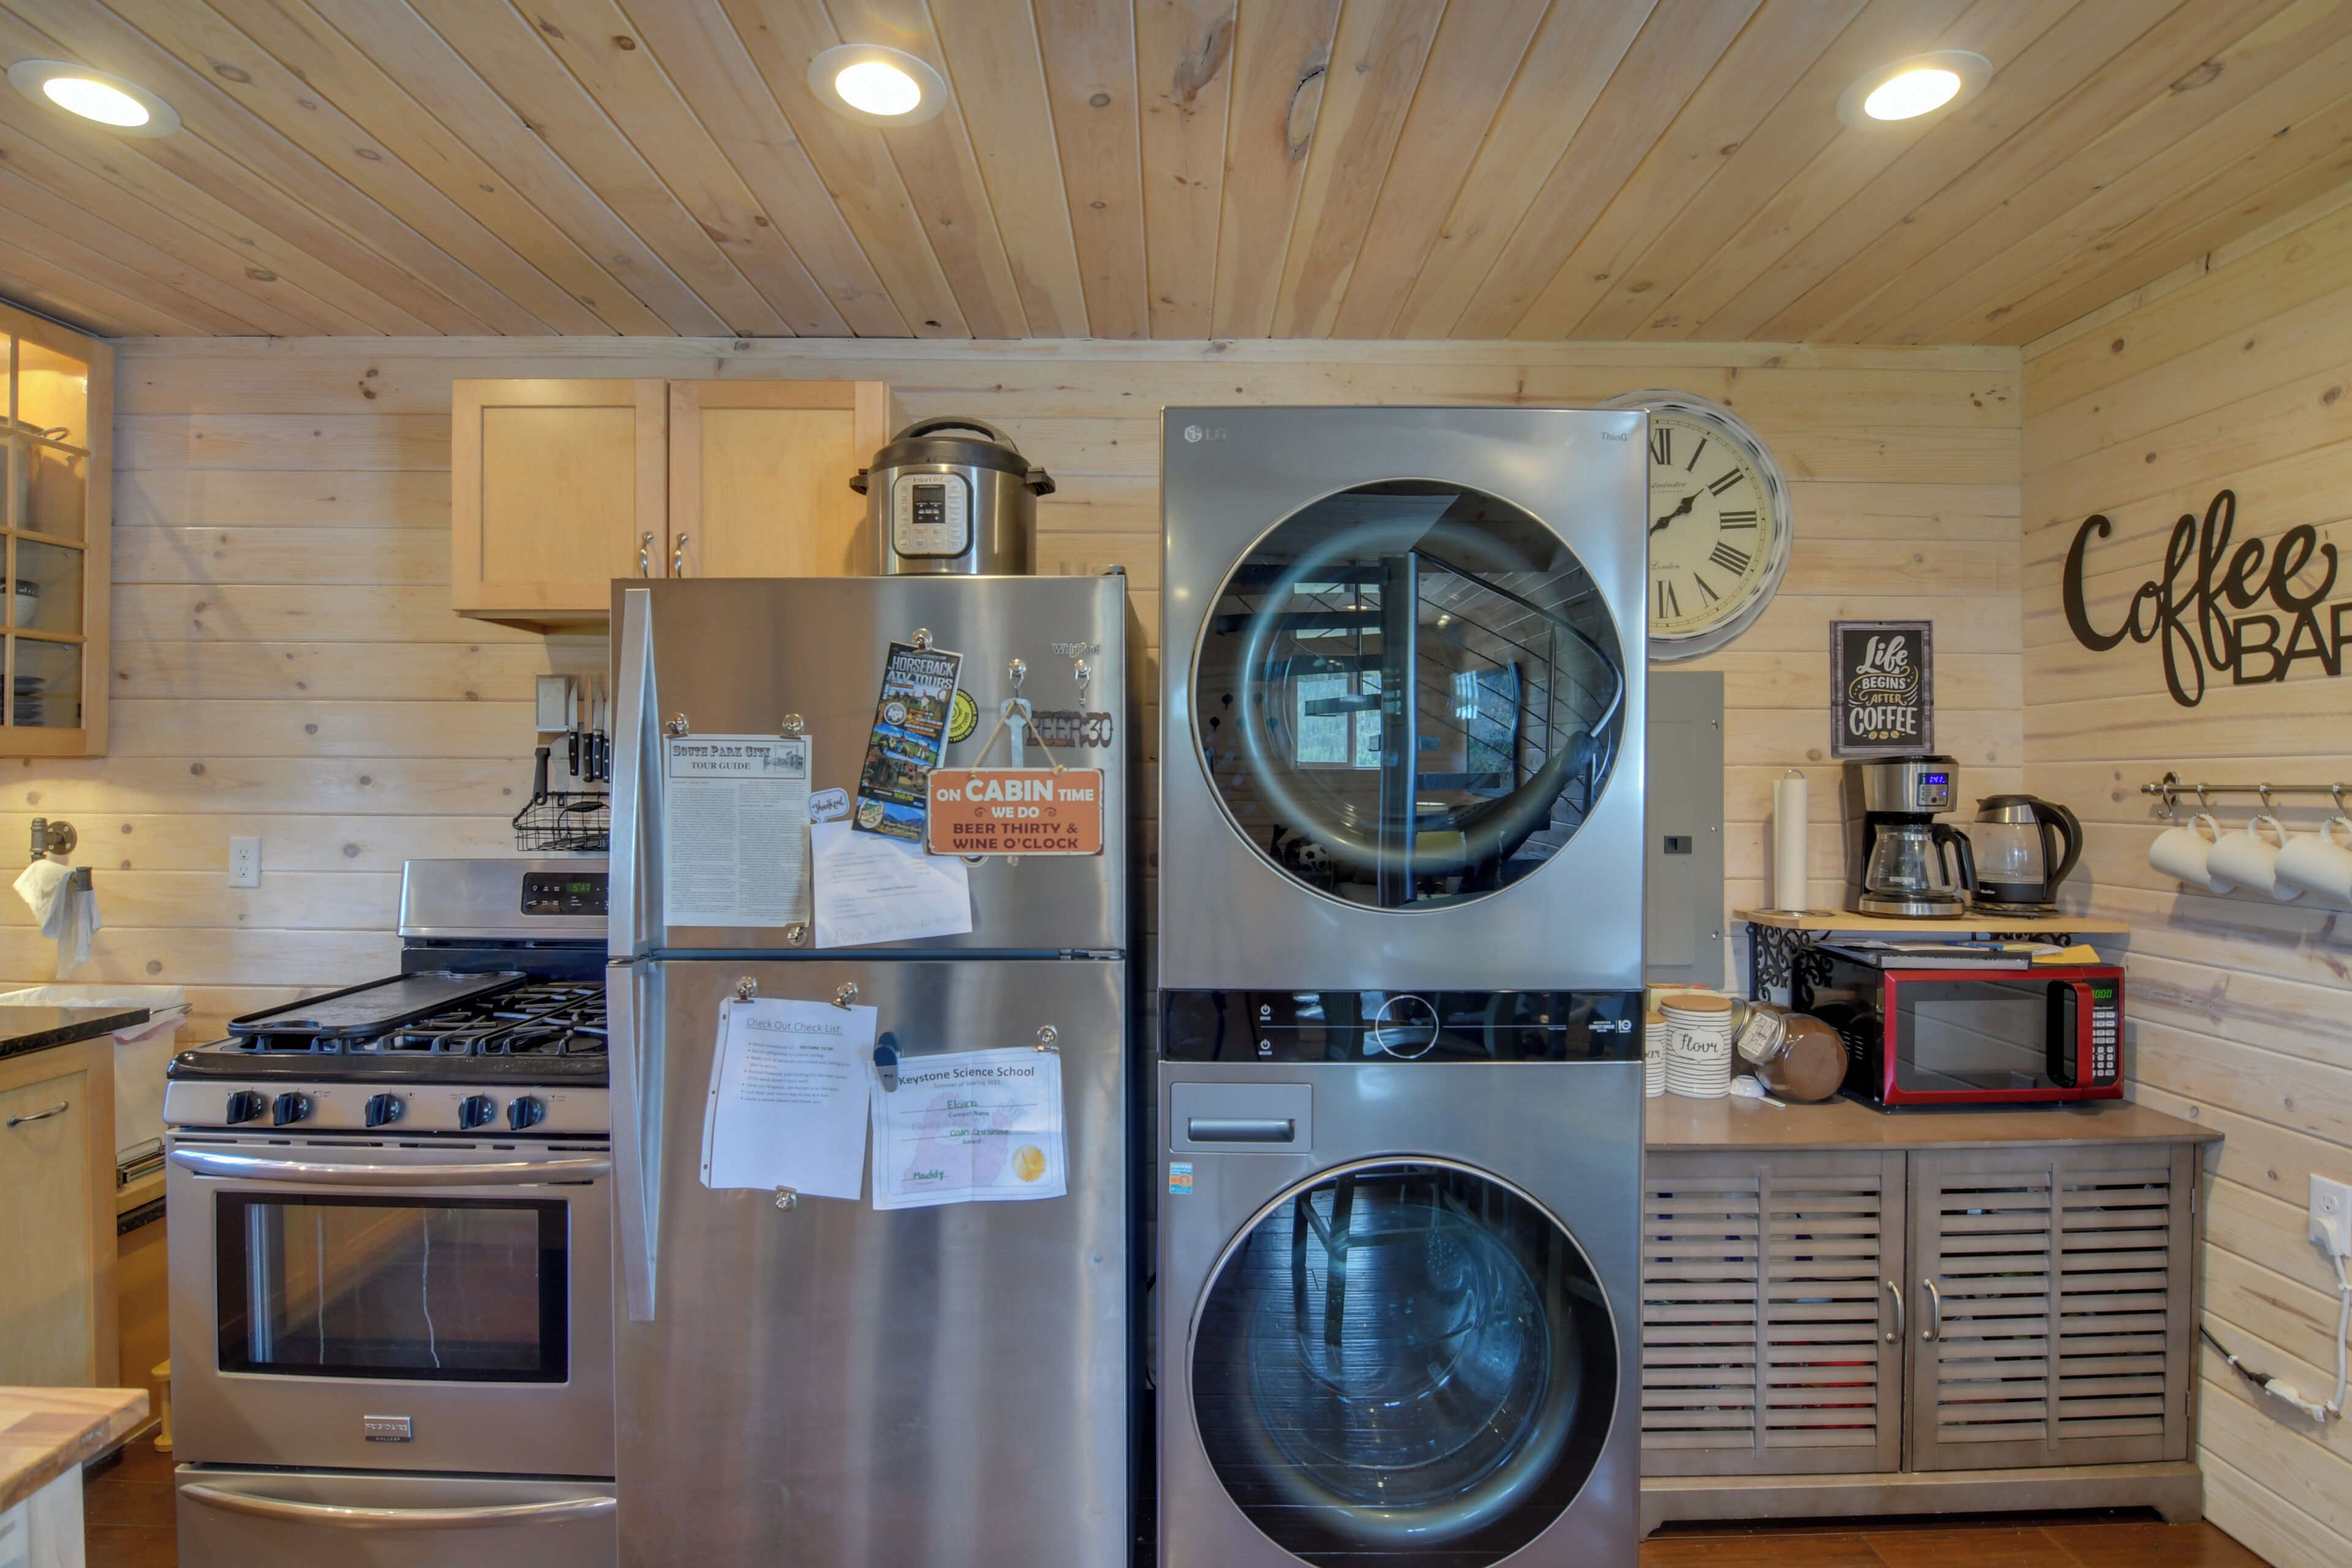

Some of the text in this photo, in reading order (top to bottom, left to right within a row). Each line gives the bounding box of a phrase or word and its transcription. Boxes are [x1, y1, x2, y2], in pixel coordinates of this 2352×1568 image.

[1206, 428, 1227, 440] LG
[1601, 432, 1627, 441] ThinQ
[2063, 489, 2338, 707] Coffee
[1856, 636, 1909, 674] Life
[891, 655, 955, 677] HORSEBACK
[914, 673, 954, 689] TOURS
[1862, 676, 1906, 689] BEGINS
[1866, 693, 1907, 706] AFTER
[1849, 706, 1918, 736] COFFEE
[691, 761, 751, 770] TOUR GUIDE
[936, 789, 961, 802] ON
[965, 779, 1054, 802] CABIN
[1058, 789, 1094, 802] TIME
[991, 807, 1039, 818] WE DO
[953, 823, 1078, 834] BEER THIRTY &
[953, 838, 1079, 849] WINE O'CLOCK
[747, 1018, 772, 1028] Check
[774, 1021, 791, 1031] Out
[794, 1022, 823, 1032] Check
[1618, 1019, 1632, 1030] 10
[1679, 1033, 1719, 1053] Flour
[898, 1066, 1034, 1085] Keystone Science School
